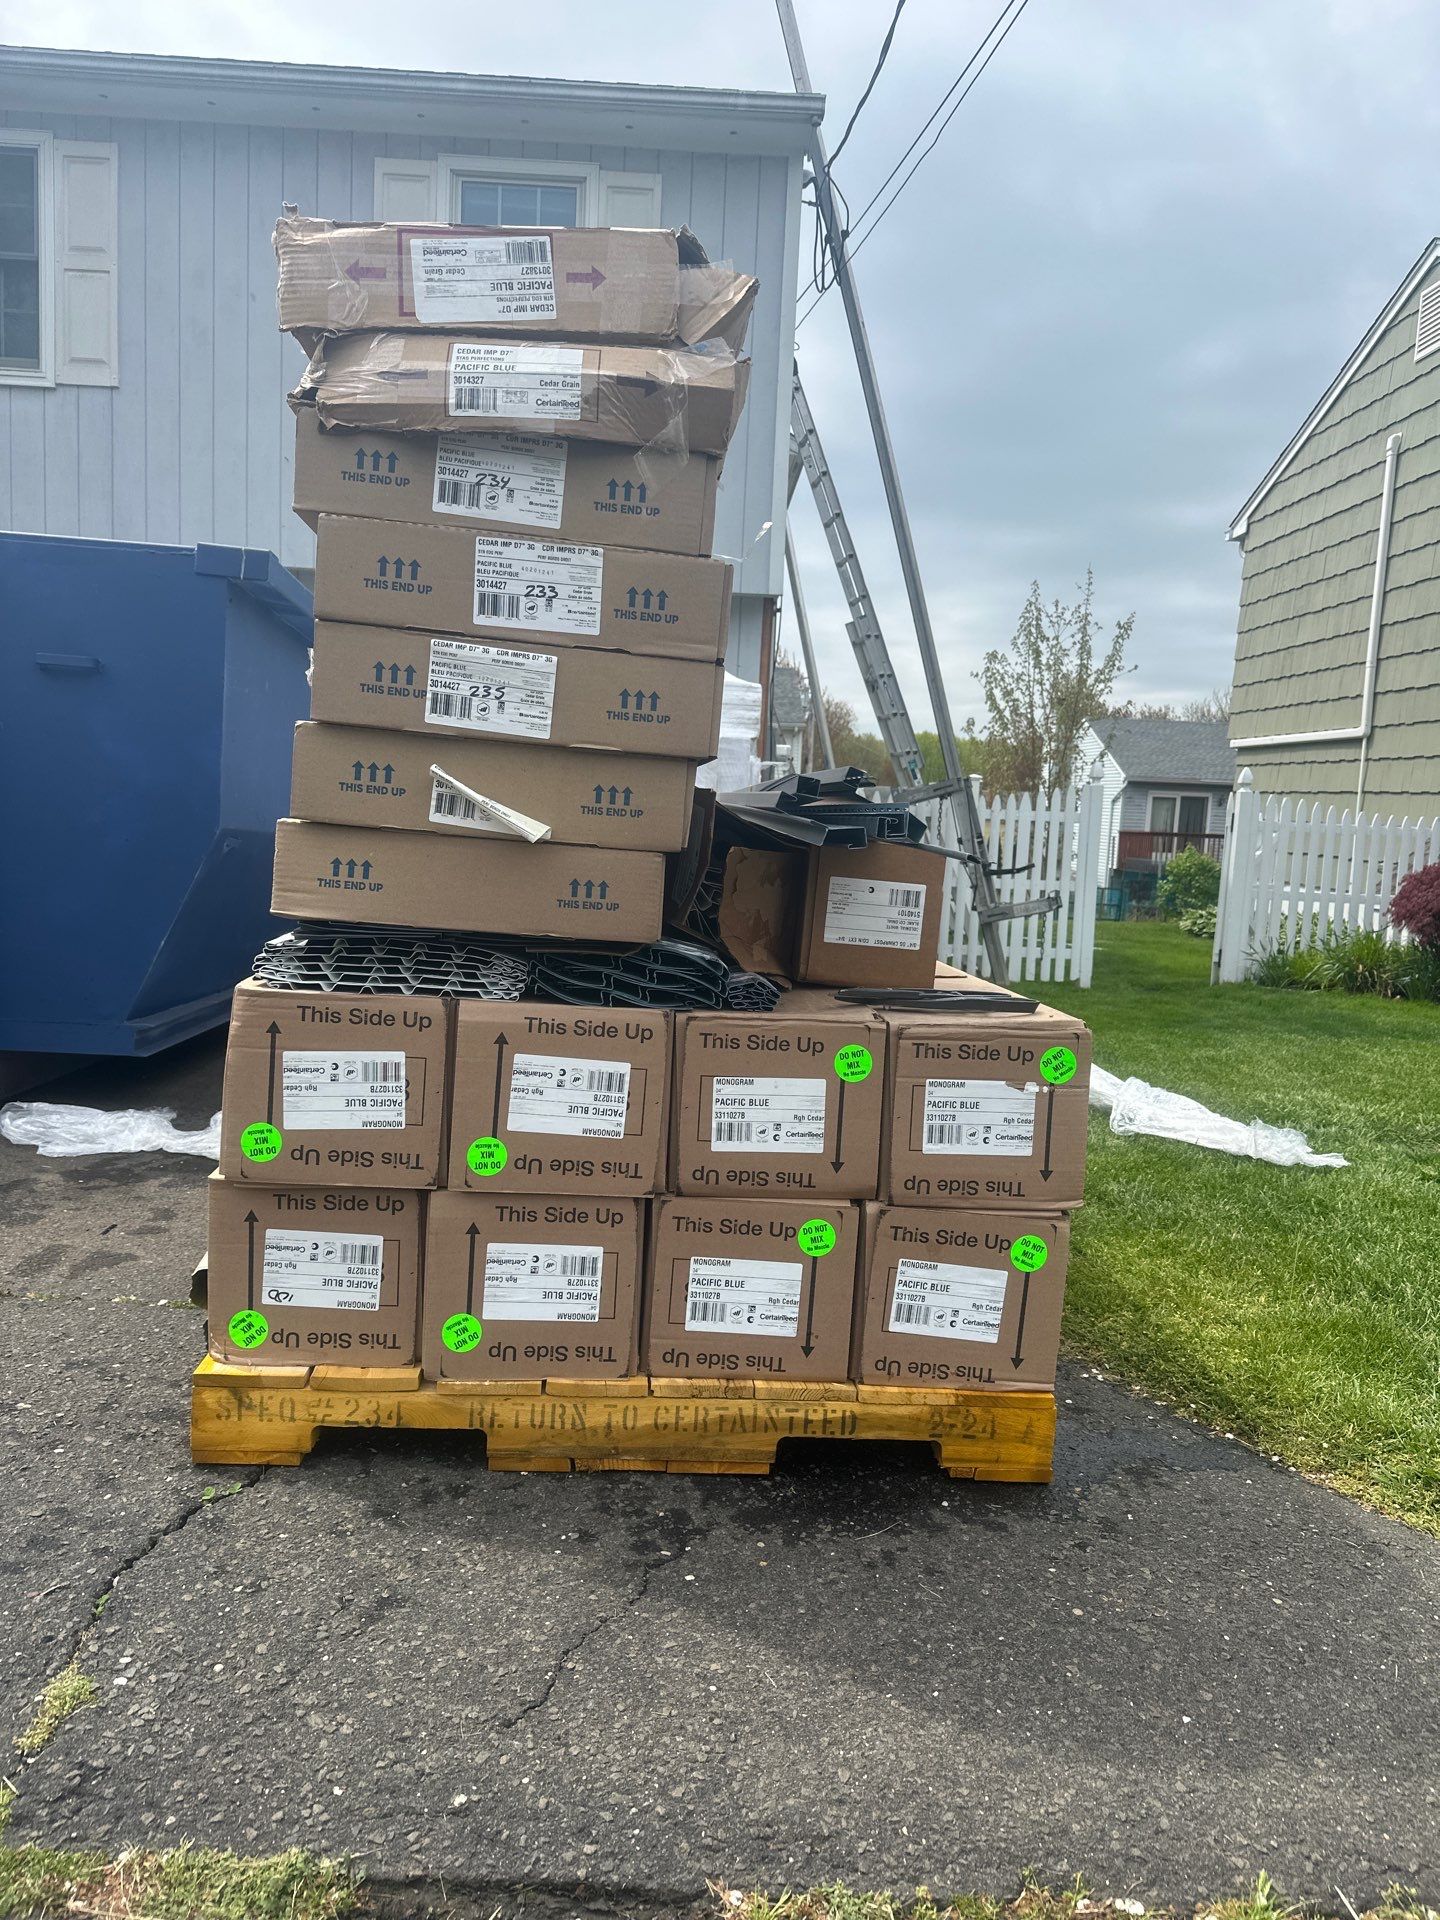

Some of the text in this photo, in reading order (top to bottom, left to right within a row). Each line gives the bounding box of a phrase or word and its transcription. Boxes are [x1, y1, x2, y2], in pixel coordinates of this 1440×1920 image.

[491, 281, 552, 291] PACIFIC BLUE
[454, 376, 484, 384] 3014327
[536, 399, 579, 408] CertainTeed
[440, 448, 460, 456] PACIFIC
[454, 457, 481, 466] PACIFIQUE
[438, 466, 468, 478] 3014427
[341, 471, 410, 487] THIS END UP
[475, 474, 510, 489] 234
[594, 502, 660, 516] THIS END UP
[556, 546, 576, 554] IMPRS
[492, 569, 519, 577] PACIFIQUE
[364, 578, 432, 594] THIS END UP
[476, 579, 507, 590] 3014427
[524, 585, 559, 599] 233
[614, 609, 679, 624] THIS END UP
[446, 671, 472, 679] PACIFIQUE
[430, 679, 460, 691] 3014427
[360, 683, 427, 699] THIS END UP
[607, 711, 670, 724] THIS END UP
[339, 782, 406, 797] THIS END UP
[581, 806, 643, 818] THIS END UP
[317, 878, 383, 892] THIS END UP
[557, 899, 619, 911] THIS END UP
[297, 1006, 432, 1031] This Side Up
[525, 1017, 653, 1043] This Side Up
[700, 1033, 824, 1056] This Side Up
[840, 1050, 864, 1060] DO NOT
[912, 1043, 1034, 1065] This Side Up
[847, 1061, 860, 1069] MIX
[513, 1070, 552, 1078] CertainTeed
[370, 1099, 402, 1107] PACIFIC
[715, 1098, 769, 1107] PACIFIC BLUE
[927, 1101, 956, 1109] PACIFIC
[568, 1106, 623, 1117] PACIFIC BLUE
[582, 1128, 621, 1136] MONOGRAM
[273, 1194, 404, 1215] This Side Up
[495, 1206, 623, 1227] This Side Up
[672, 1216, 797, 1241] This Side Up
[890, 1226, 1011, 1253] This Side Up
[693, 1259, 731, 1267] MONOGRAM
[901, 1261, 938, 1270] MONOGRAM
[347, 1281, 378, 1289] PACIFIC
[692, 1278, 745, 1288] PACIFIC BLUE
[898, 1280, 950, 1292] PACIFIC BLUE
[543, 1291, 564, 1299] BLUE
[337, 1300, 376, 1309] MONOGRAM
[760, 1314, 797, 1322] CertainTeed
[962, 1318, 999, 1328] CertainTeed
[469, 1401, 858, 1436] RETURN TO CERTAINTEED
